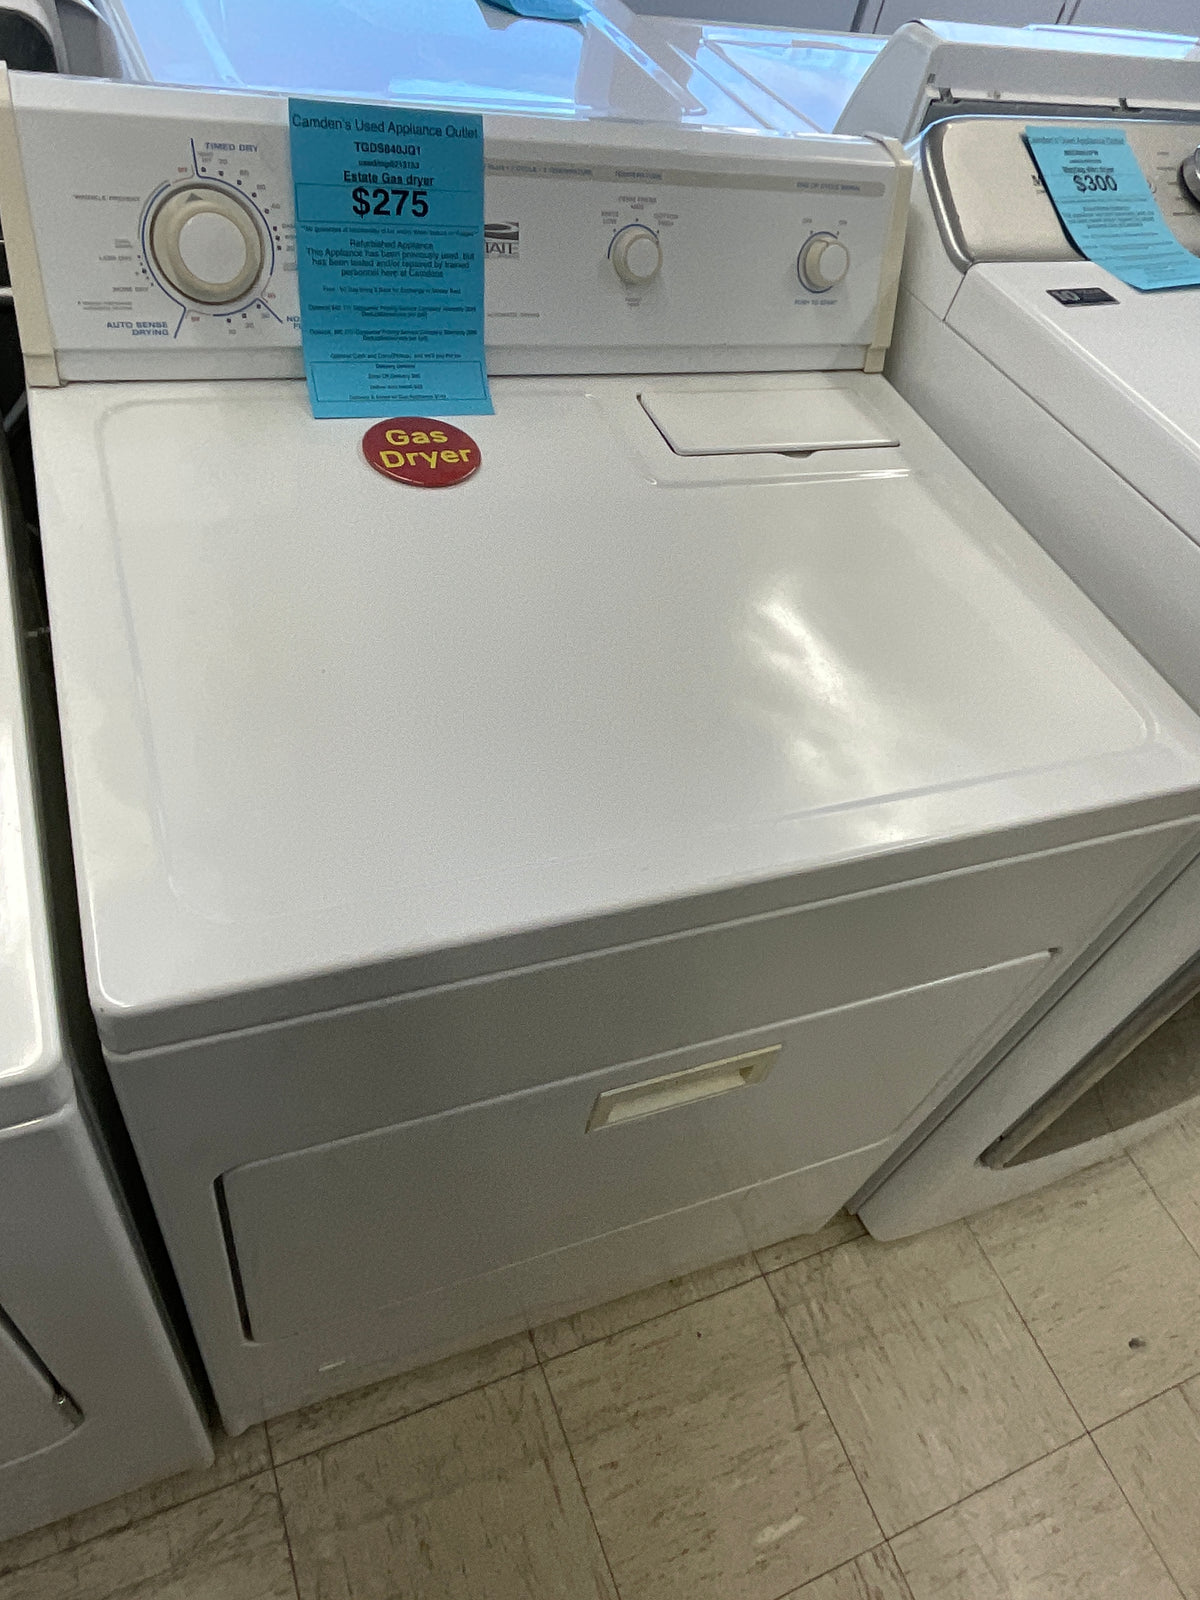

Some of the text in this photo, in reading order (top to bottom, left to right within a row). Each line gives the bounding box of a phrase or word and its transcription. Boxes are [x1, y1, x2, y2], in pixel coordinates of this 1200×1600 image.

[293, 114, 478, 139] Camden's Used Appliance Outlet
[205, 142, 258, 152] TIMED DRY
[343, 170, 434, 188] Estate Gas dryer
[1073, 174, 1118, 193] $300
[352, 187, 430, 220] $275
[306, 248, 323, 256] This
[325, 248, 362, 258] Appliance
[364, 249, 379, 257] has
[434, 261, 443, 270] by
[385, 429, 448, 446] Gas
[379, 448, 472, 469] Dryer
